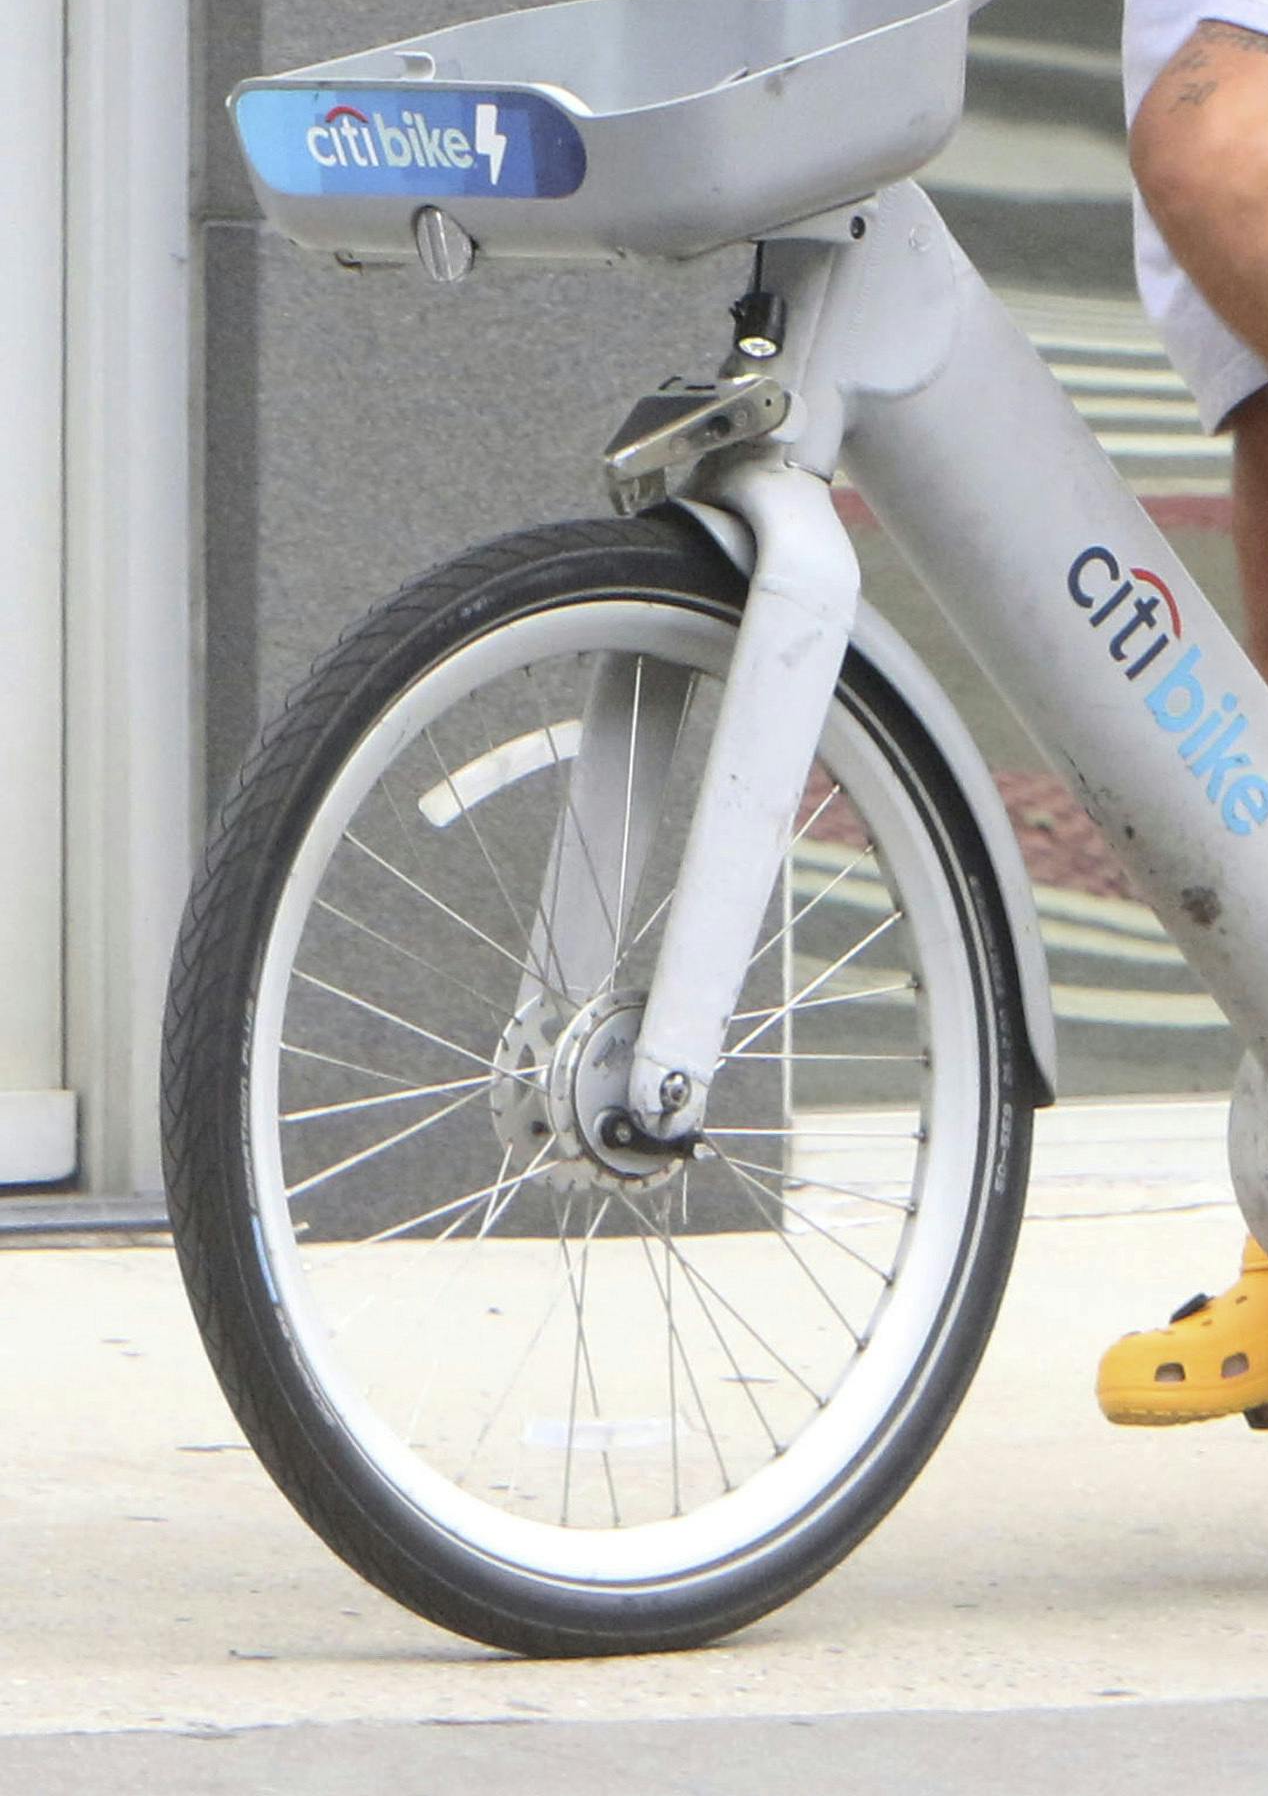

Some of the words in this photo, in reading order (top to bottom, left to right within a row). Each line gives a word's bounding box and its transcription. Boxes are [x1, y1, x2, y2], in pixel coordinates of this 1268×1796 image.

[306, 106, 378, 168] citi
[373, 110, 475, 169] bike
[1067, 545, 1182, 682] citi
